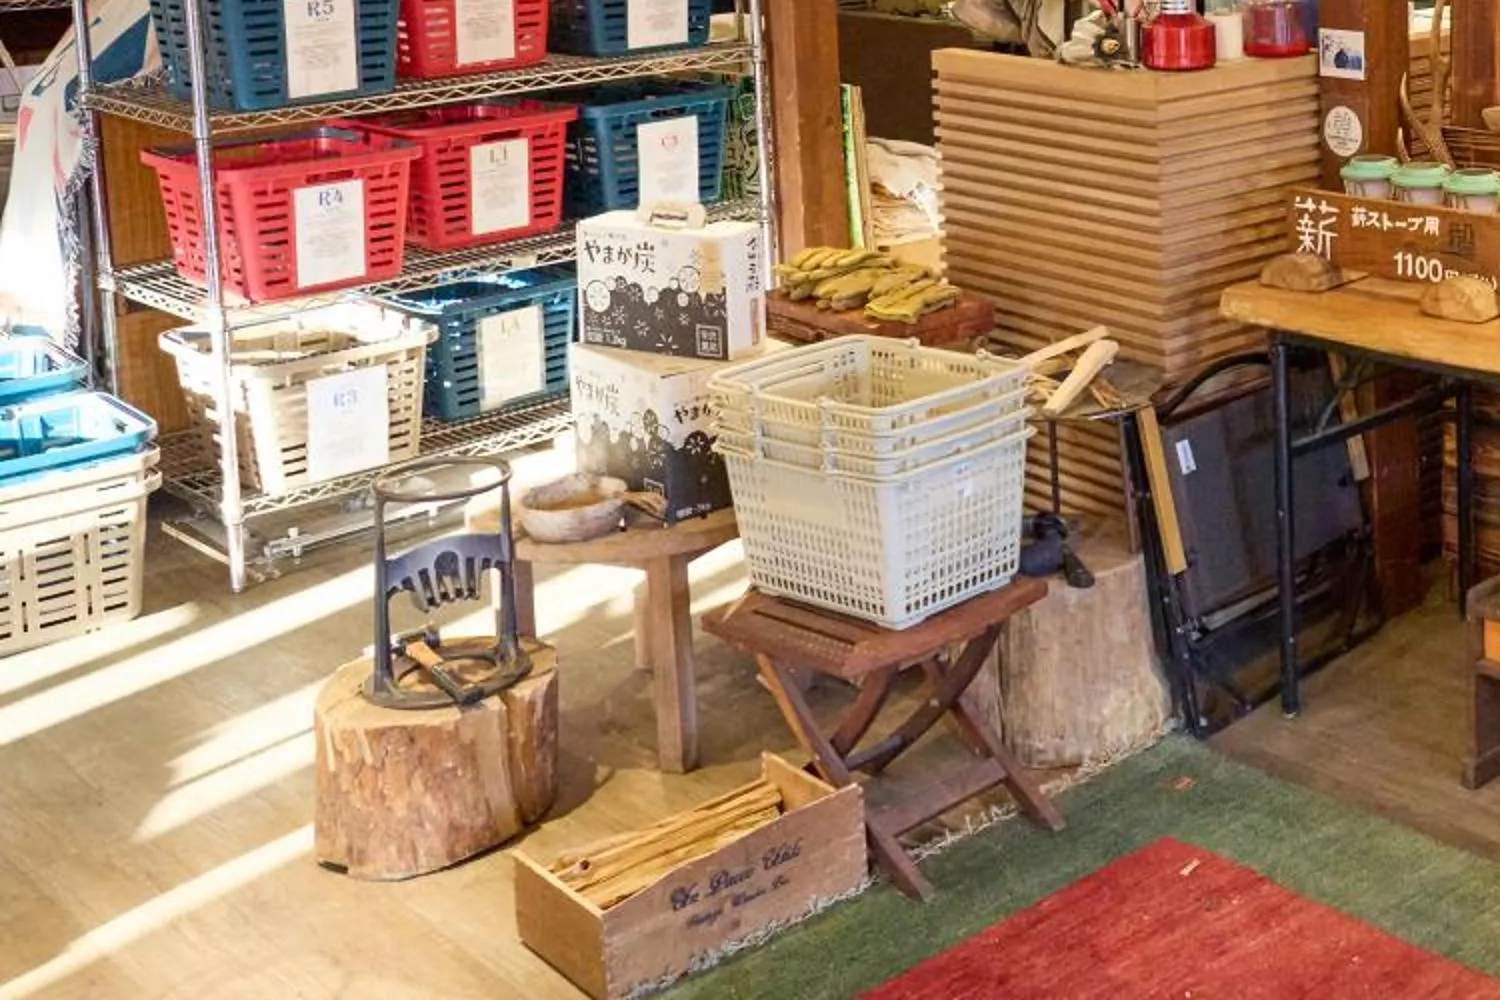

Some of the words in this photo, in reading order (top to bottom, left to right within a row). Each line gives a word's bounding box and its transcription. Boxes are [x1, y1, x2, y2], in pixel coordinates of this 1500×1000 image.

[307, 0, 335, 17] R5
[584, 240, 656, 274] やまが炭
